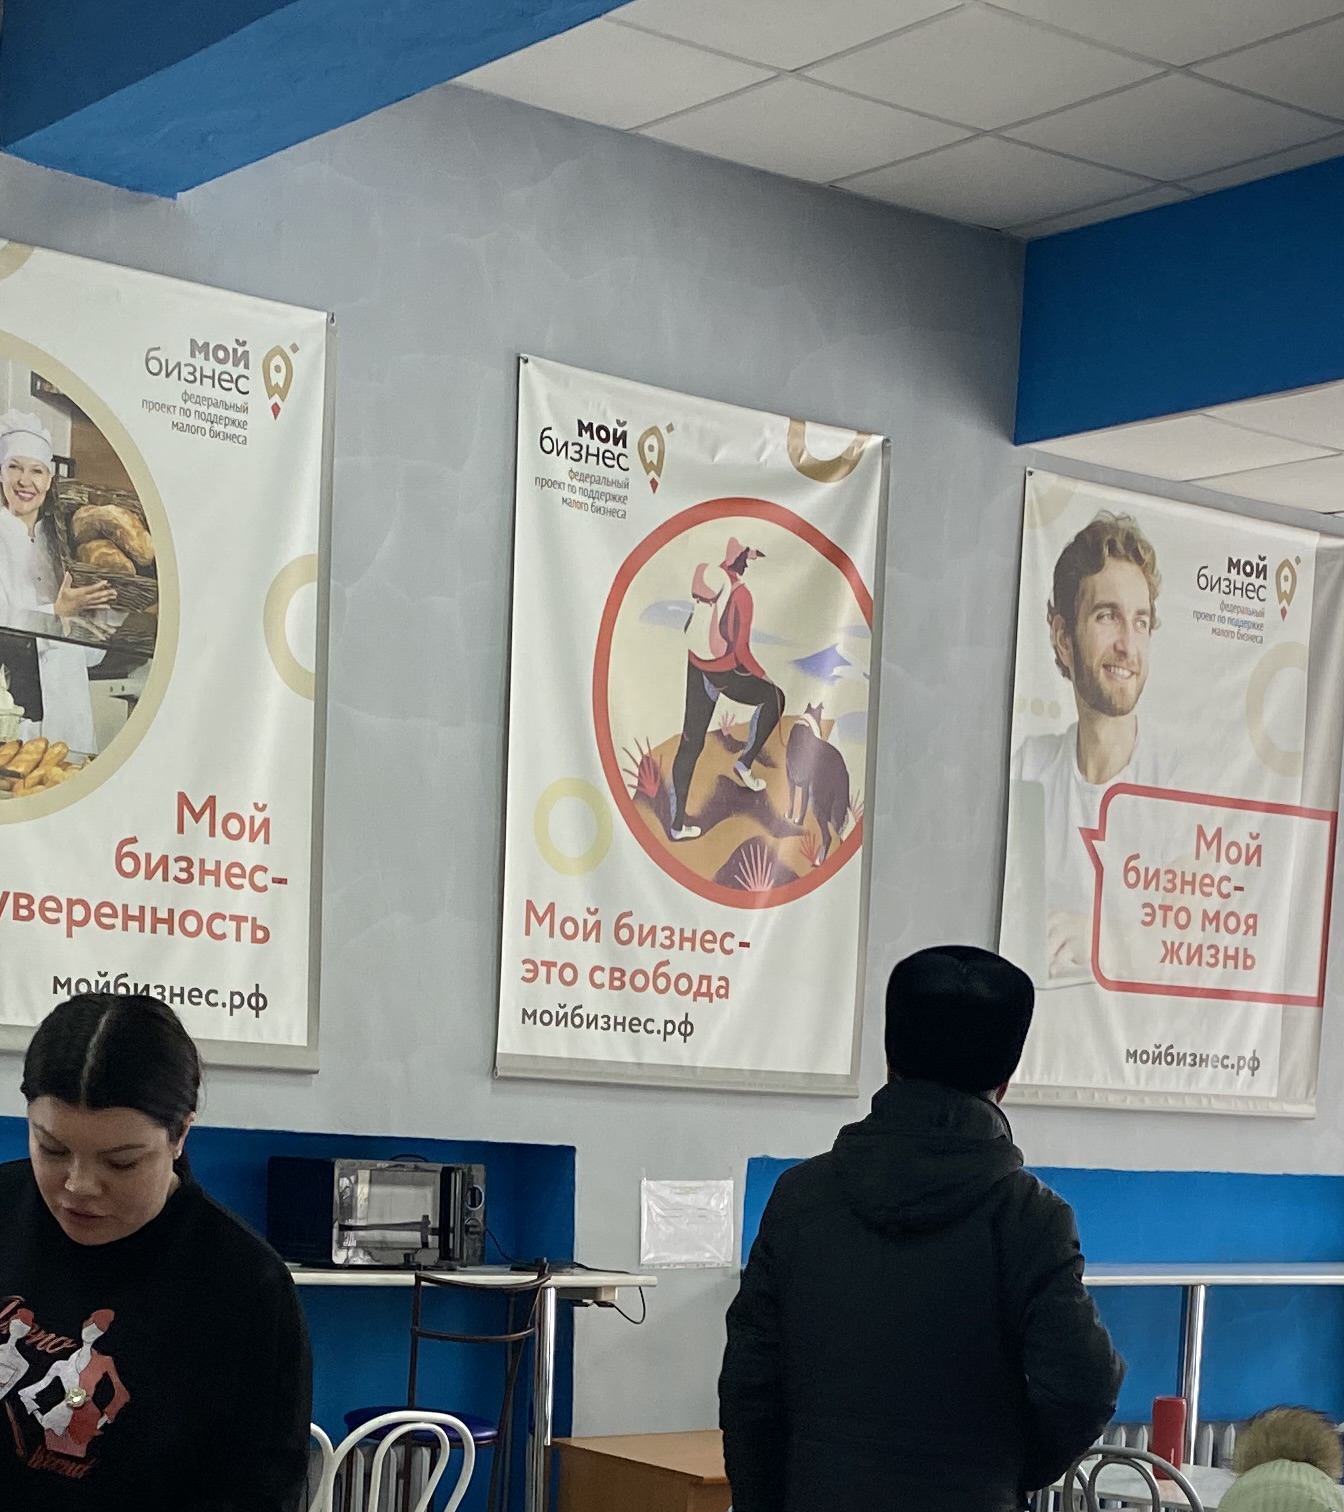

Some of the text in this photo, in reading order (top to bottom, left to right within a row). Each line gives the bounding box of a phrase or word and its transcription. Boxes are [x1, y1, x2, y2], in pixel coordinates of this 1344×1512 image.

[144, 346, 250, 395] бизнес
[189, 338, 250, 370] мой
[141, 399, 248, 430] проект по поддержке
[181, 389, 249, 415] федеральный
[171, 420, 247, 446] малого бизнеса
[539, 426, 630, 472] бизнес
[577, 418, 627, 449] мой
[534, 476, 628, 505] проект по поддержке
[568, 467, 630, 490] федеральный
[561, 496, 627, 519] малого бизнеса
[1197, 565, 1267, 602] бизнес
[1227, 554, 1267, 581] мой
[1219, 600, 1265, 618] федеральный
[176, 791, 271, 845] Мой
[1194, 823, 1263, 868] Мой
[114, 836, 288, 893] бизнес-
[1122, 853, 1245, 900] бизнес-
[524, 899, 751, 956] Мой бизнес-
[1140, 902, 1258, 937] это моя
[1159, 939, 1256, 972] жизнь
[52, 971, 269, 1019] мойбизнес.рф
[520, 958, 731, 1004] это свобода
[521, 1003, 695, 1043] мойбизнес.рф
[1125, 1043, 1261, 1076] мойбизнес.рф
